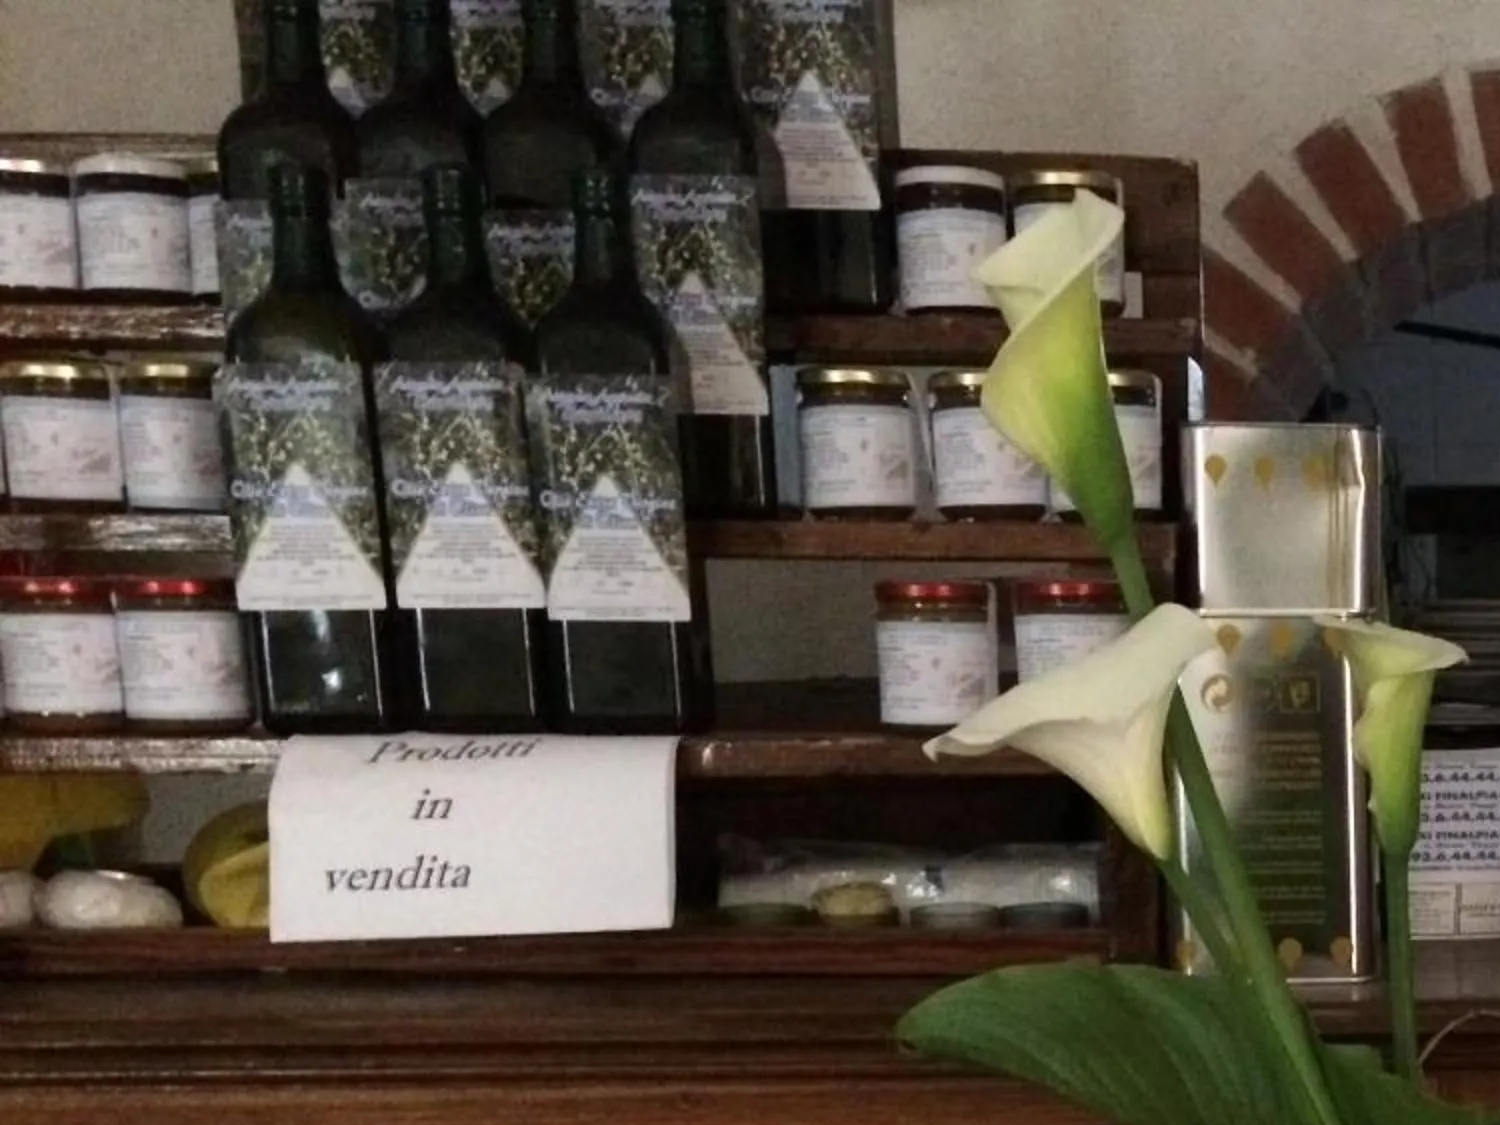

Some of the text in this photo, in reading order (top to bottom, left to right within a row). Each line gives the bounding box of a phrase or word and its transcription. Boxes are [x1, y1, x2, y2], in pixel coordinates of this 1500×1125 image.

[366, 738, 543, 764] Prodotti
[411, 788, 453, 820] in
[324, 854, 472, 892] vendita
